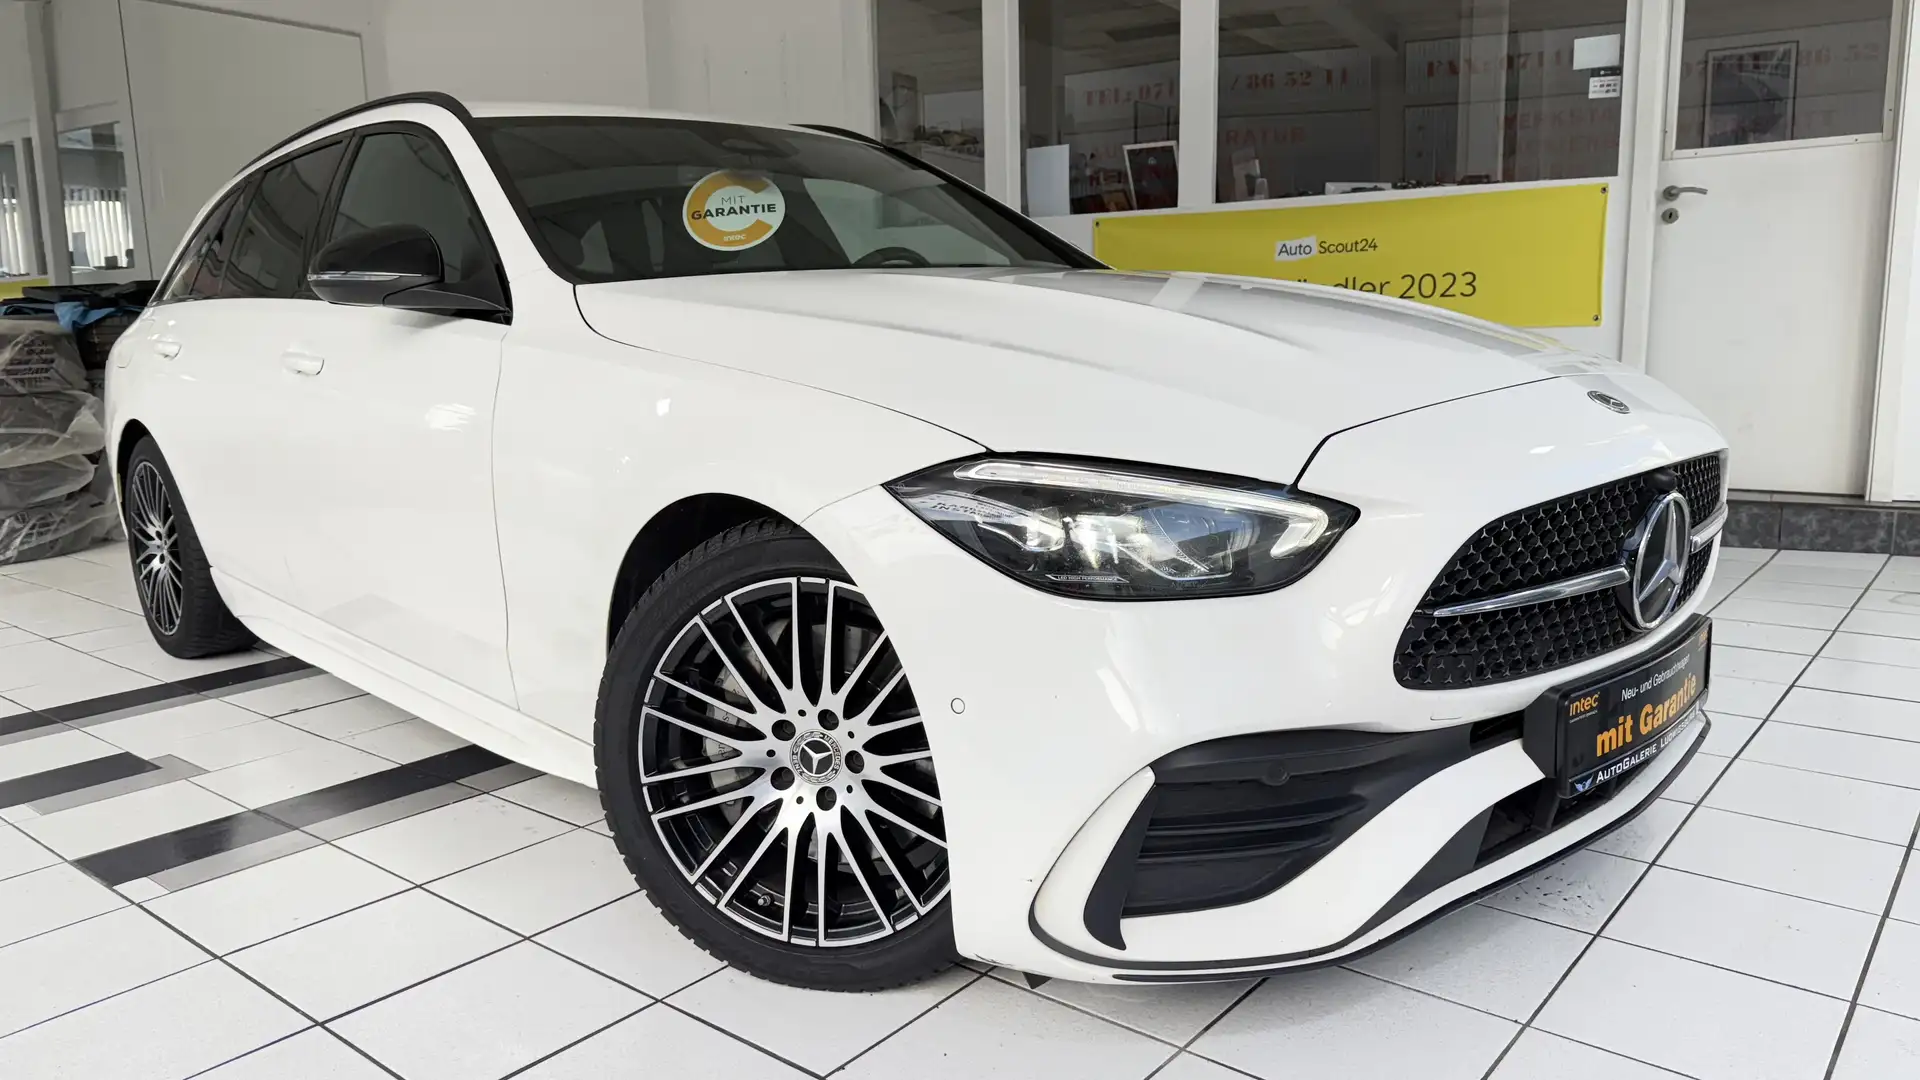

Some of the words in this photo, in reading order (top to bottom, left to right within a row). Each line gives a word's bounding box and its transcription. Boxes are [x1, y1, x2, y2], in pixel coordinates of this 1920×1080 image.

[721, 195, 746, 206] MIT
[691, 203, 777, 221] GARANTIE
[1277, 243, 1312, 256] Auto
[1319, 238, 1378, 254] Scout24
[1399, 271, 1477, 299] 2023
[1621, 687, 1639, 702] Neu-
[1640, 677, 1653, 693] und
[1596, 714, 1634, 758] mit
[1639, 672, 1697, 736] Garantie
